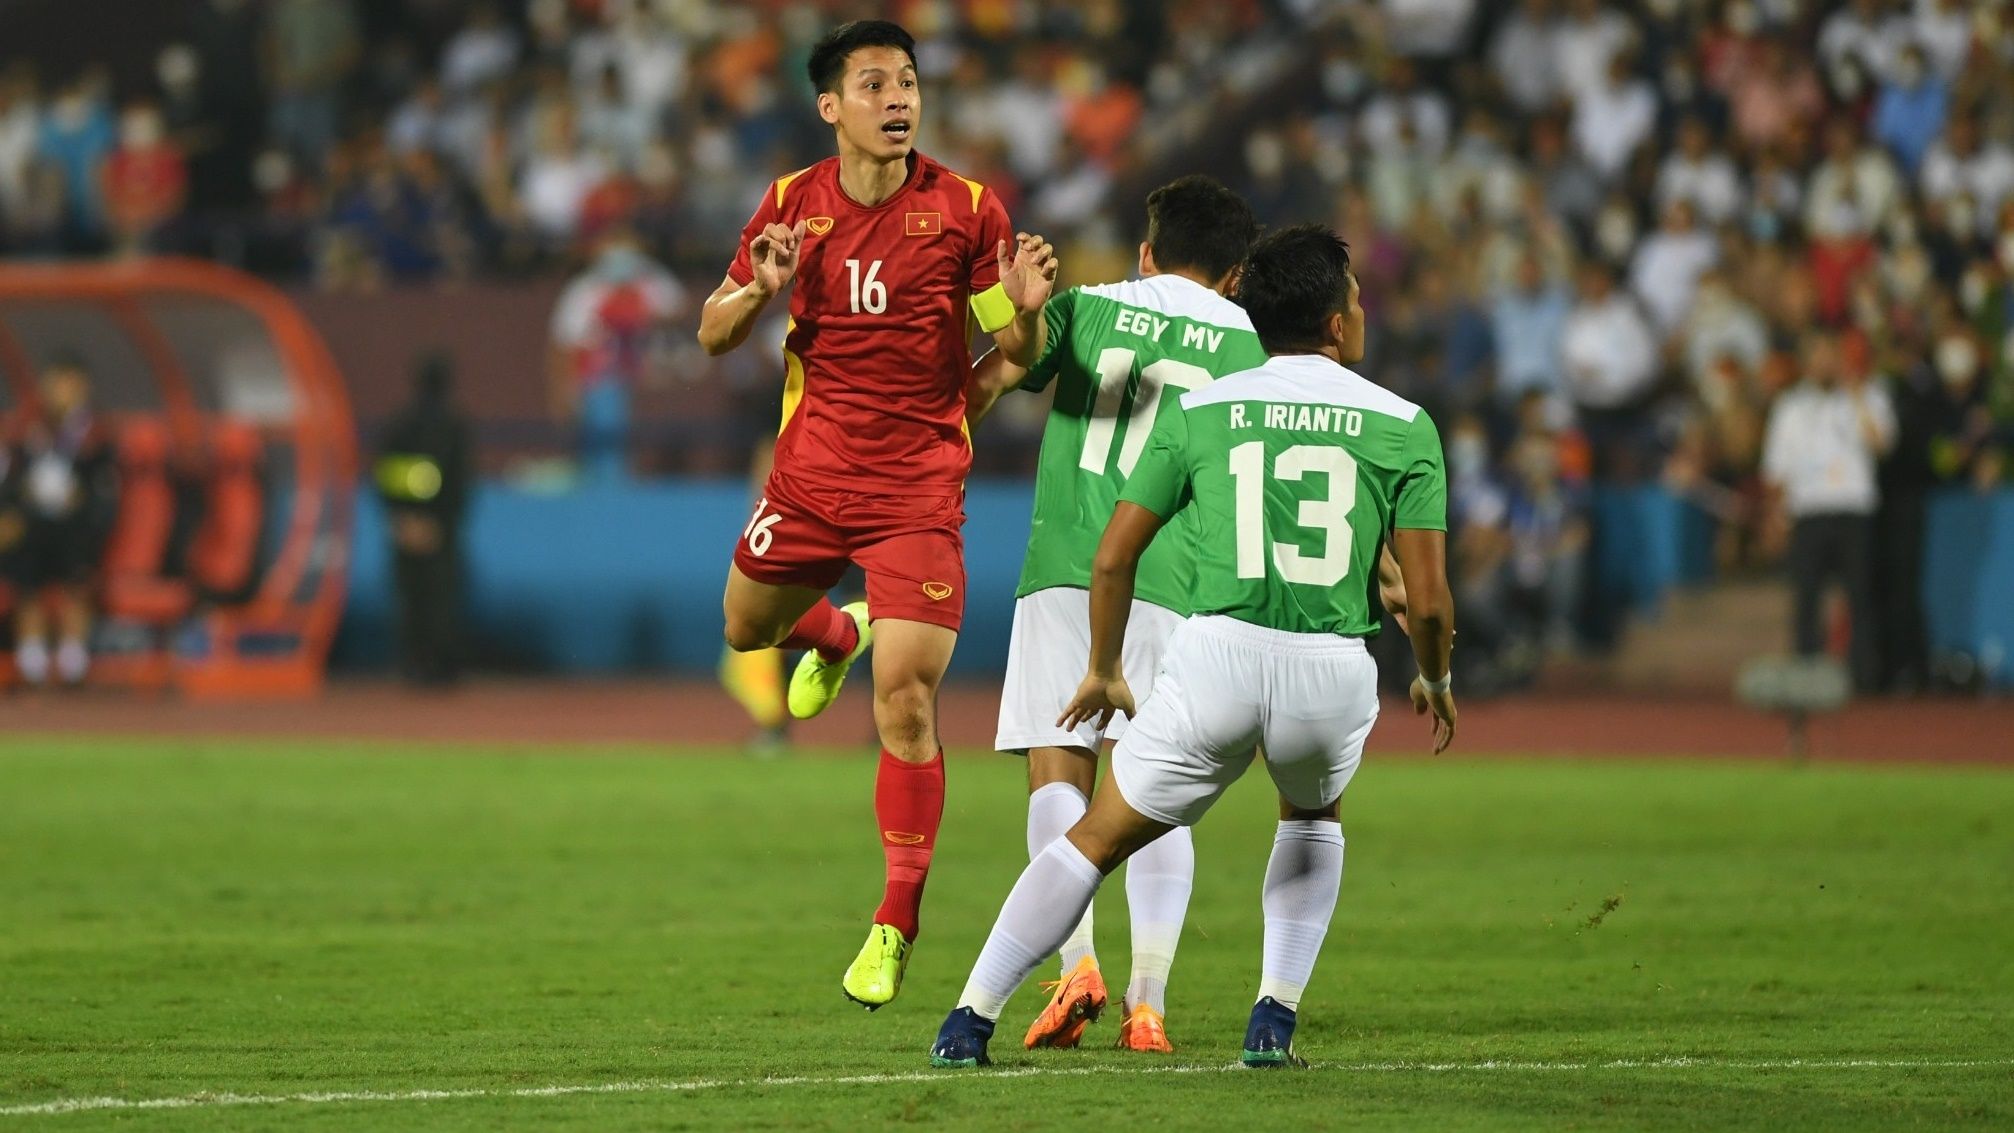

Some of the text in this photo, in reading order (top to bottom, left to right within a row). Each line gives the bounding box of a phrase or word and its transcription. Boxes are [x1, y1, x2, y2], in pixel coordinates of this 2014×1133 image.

[845, 259, 887, 315] 16
[1114, 308, 1225, 354] EGY MV
[1230, 403, 1363, 437] R. IRIANTO
[744, 497, 782, 557] 16
[1229, 441, 1358, 587] 13
